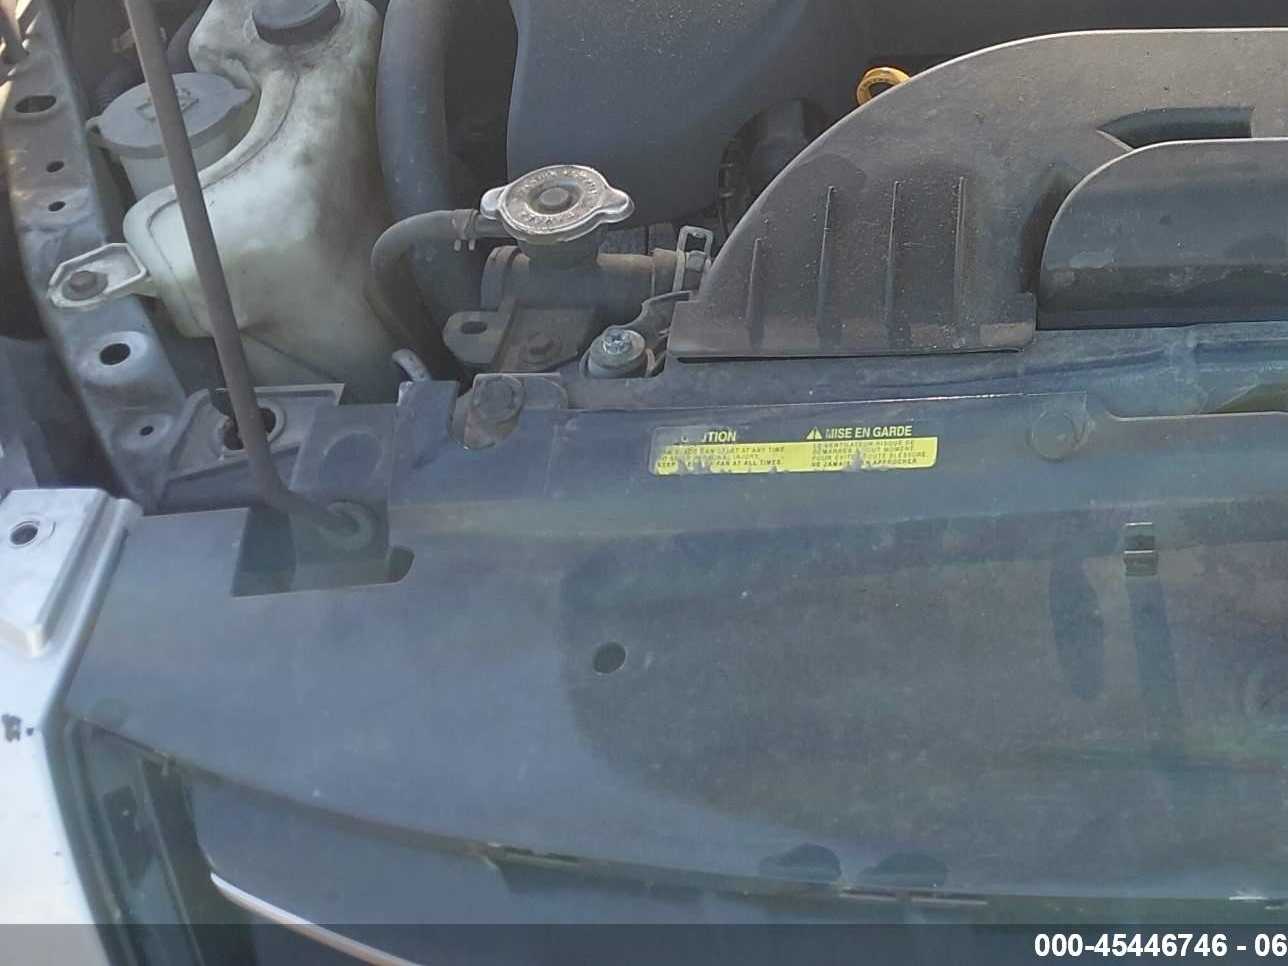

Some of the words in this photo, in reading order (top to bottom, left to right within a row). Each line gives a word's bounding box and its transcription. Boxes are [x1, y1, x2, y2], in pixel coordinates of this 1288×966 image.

[825, 428, 852, 439] MISE
[854, 427, 871, 438] EN
[872, 425, 913, 437] GARDE
